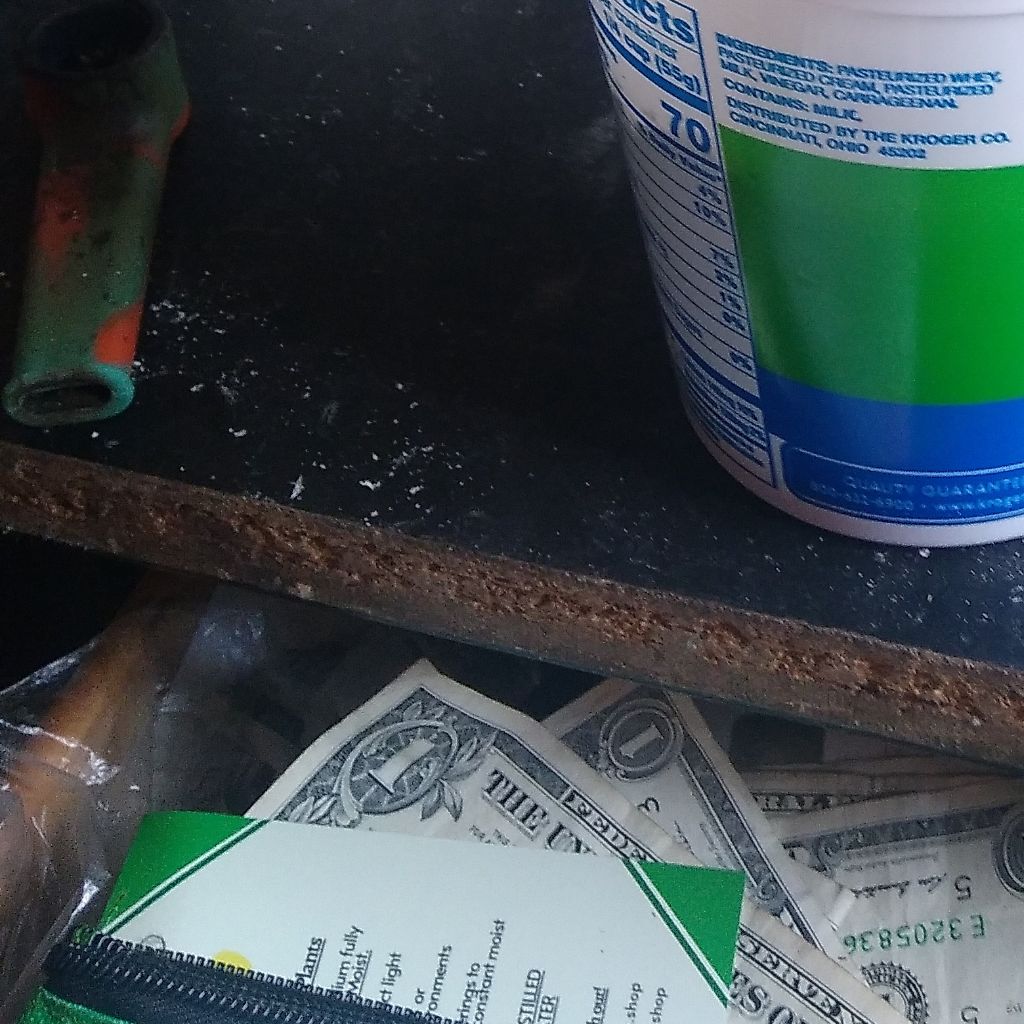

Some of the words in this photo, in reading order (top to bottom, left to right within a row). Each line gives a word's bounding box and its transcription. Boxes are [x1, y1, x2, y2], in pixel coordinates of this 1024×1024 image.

[718, 45, 815, 82] PASTEURIZED
[661, 100, 711, 153] 70
[727, 95, 831, 134] DISTRIBUTED
[836, 125, 859, 139] BY
[862, 129, 897, 144] THE
[901, 132, 977, 146] KROGER
[826, 136, 869, 155] OHIO
[480, 767, 548, 834] THE
[342, 925, 364, 955] fully
[487, 918, 506, 961] moist
[382, 952, 402, 986] light
[467, 961, 481, 979] to
[414, 987, 424, 1004] or
[518, 967, 542, 1024] STILLED
[538, 995, 558, 1024] TER
